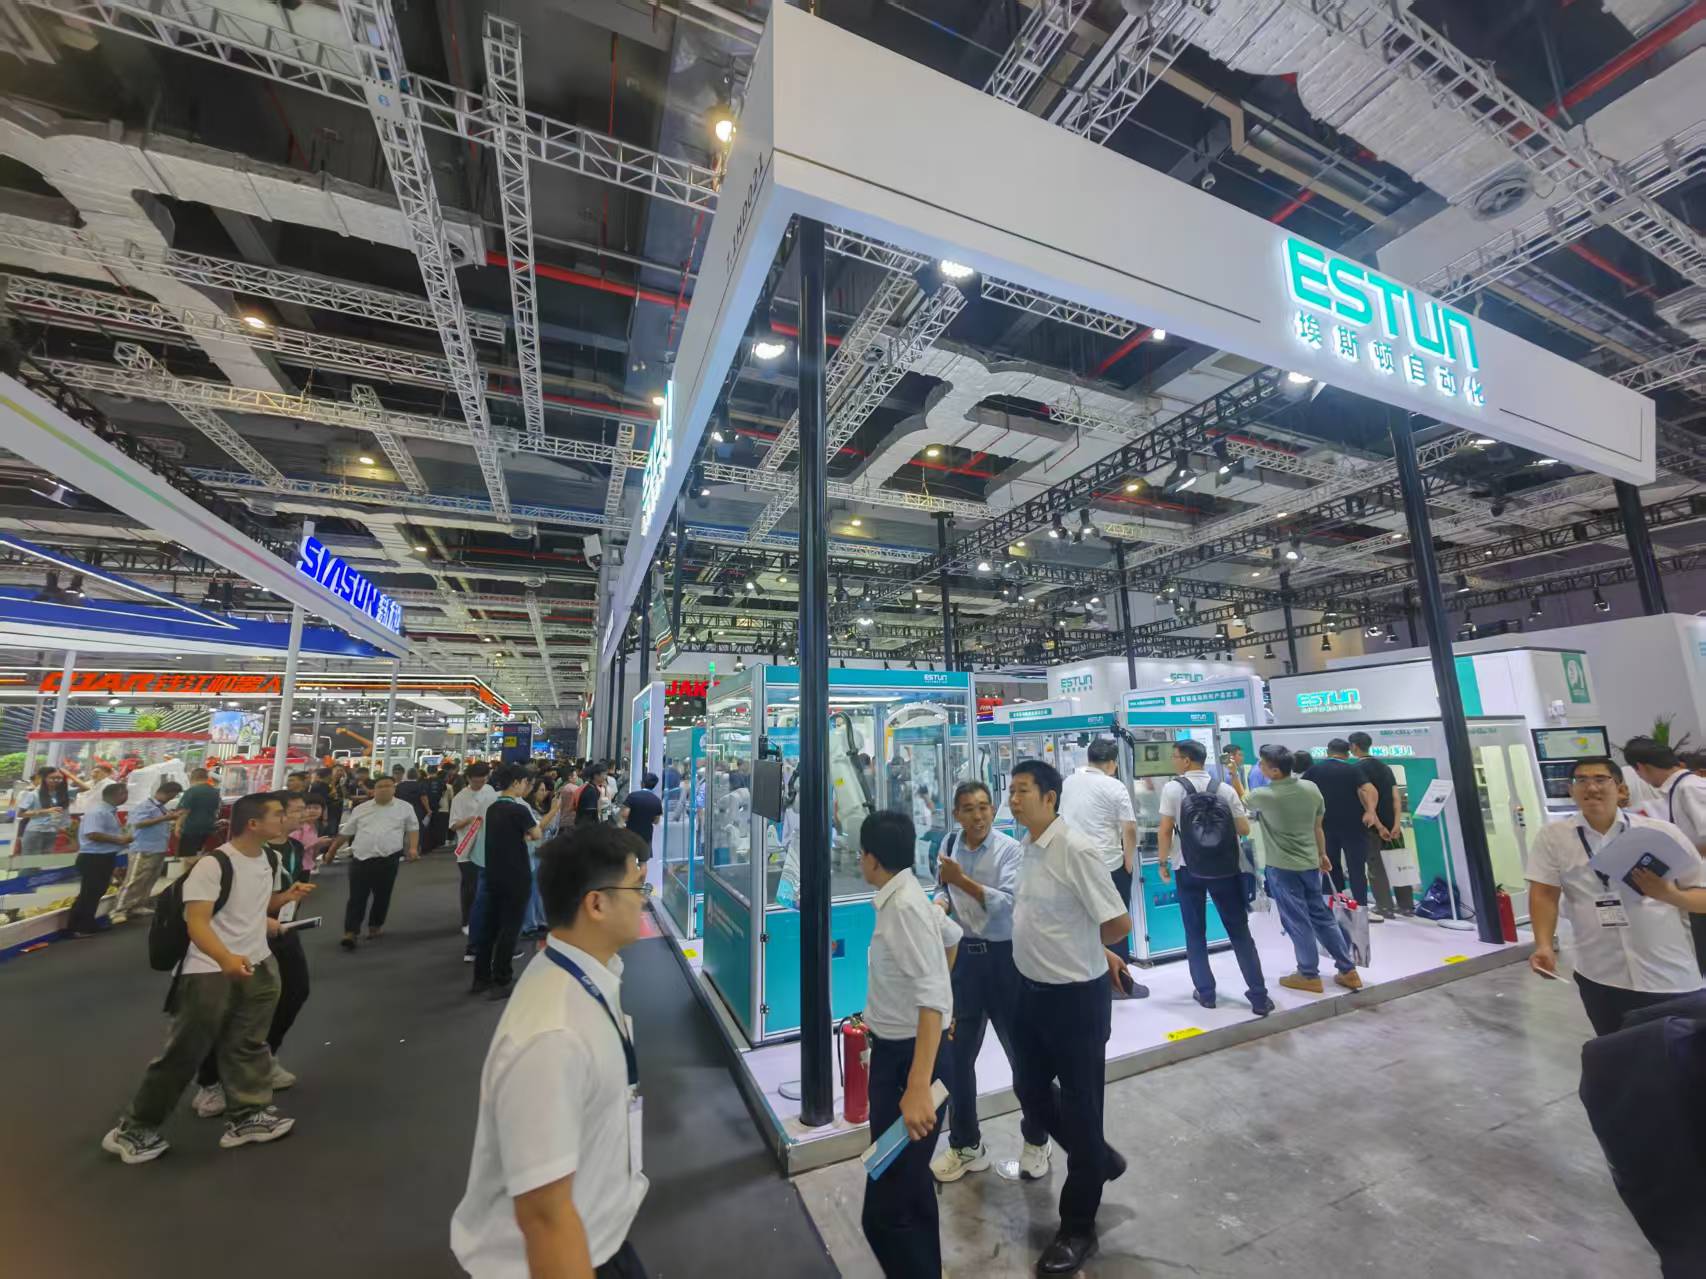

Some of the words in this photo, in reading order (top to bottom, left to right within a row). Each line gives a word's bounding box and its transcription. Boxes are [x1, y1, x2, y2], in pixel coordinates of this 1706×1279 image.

[1282, 237, 1480, 371] ESTUN
[1294, 309, 1486, 408] 埃斯顿自动化
[296, 536, 381, 619] SIASUN
[1061, 674, 1093, 688] ESTUN
[1296, 688, 1361, 707] ESTUN
